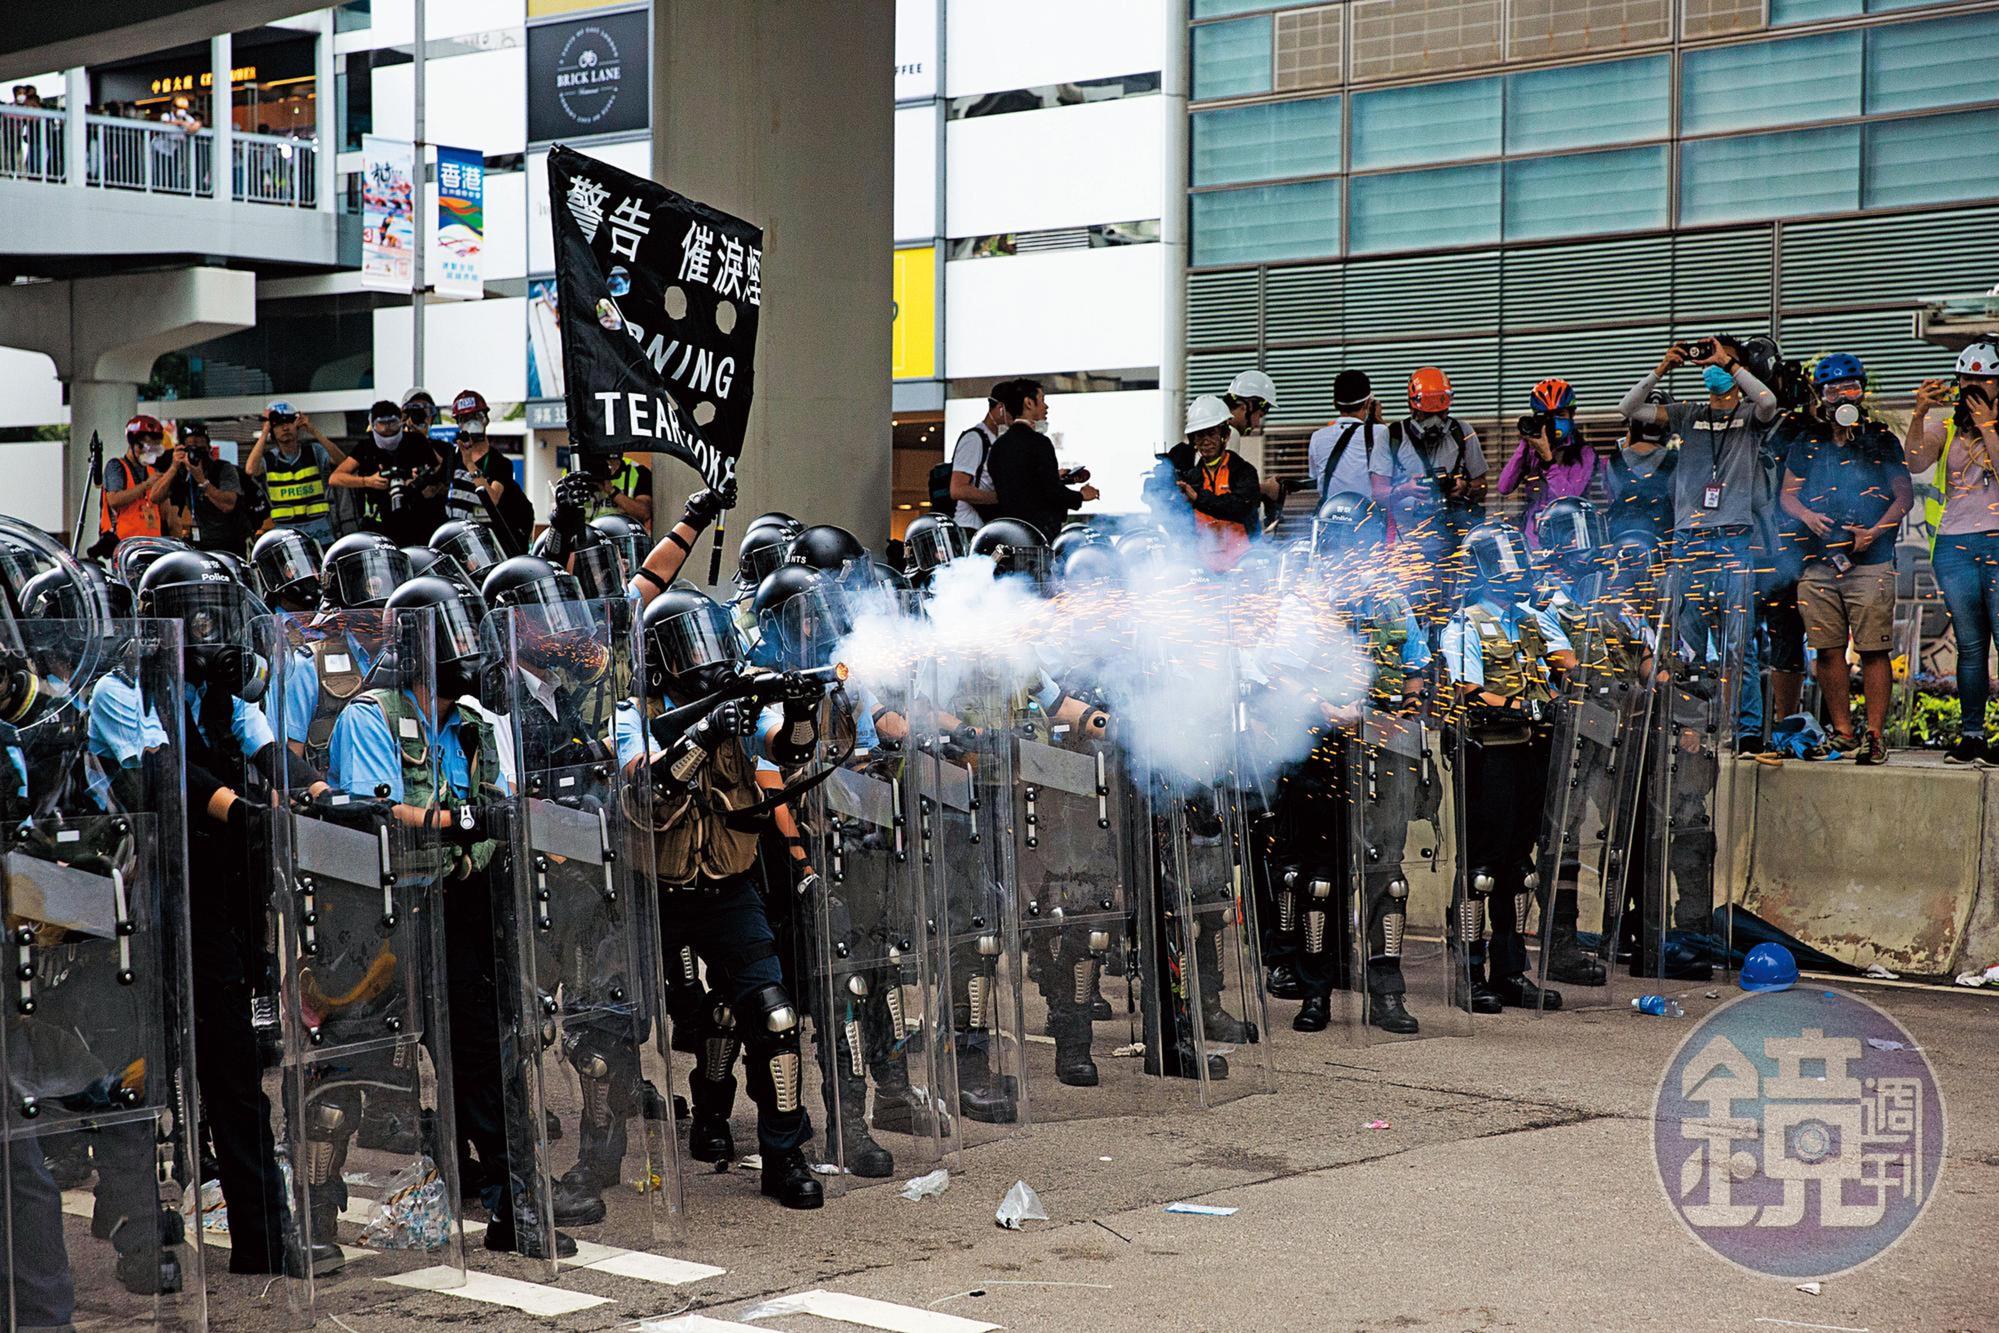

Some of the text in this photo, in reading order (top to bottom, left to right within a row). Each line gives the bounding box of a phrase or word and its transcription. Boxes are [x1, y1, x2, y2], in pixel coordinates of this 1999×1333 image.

[557, 66, 620, 88] BRICK LANE
[440, 162, 481, 191] 香港
[566, 175, 762, 305] 警告 催淚煙
[595, 391, 686, 448] TEAR
[280, 485, 314, 497] PRESS
[202, 573, 230, 582] Police
